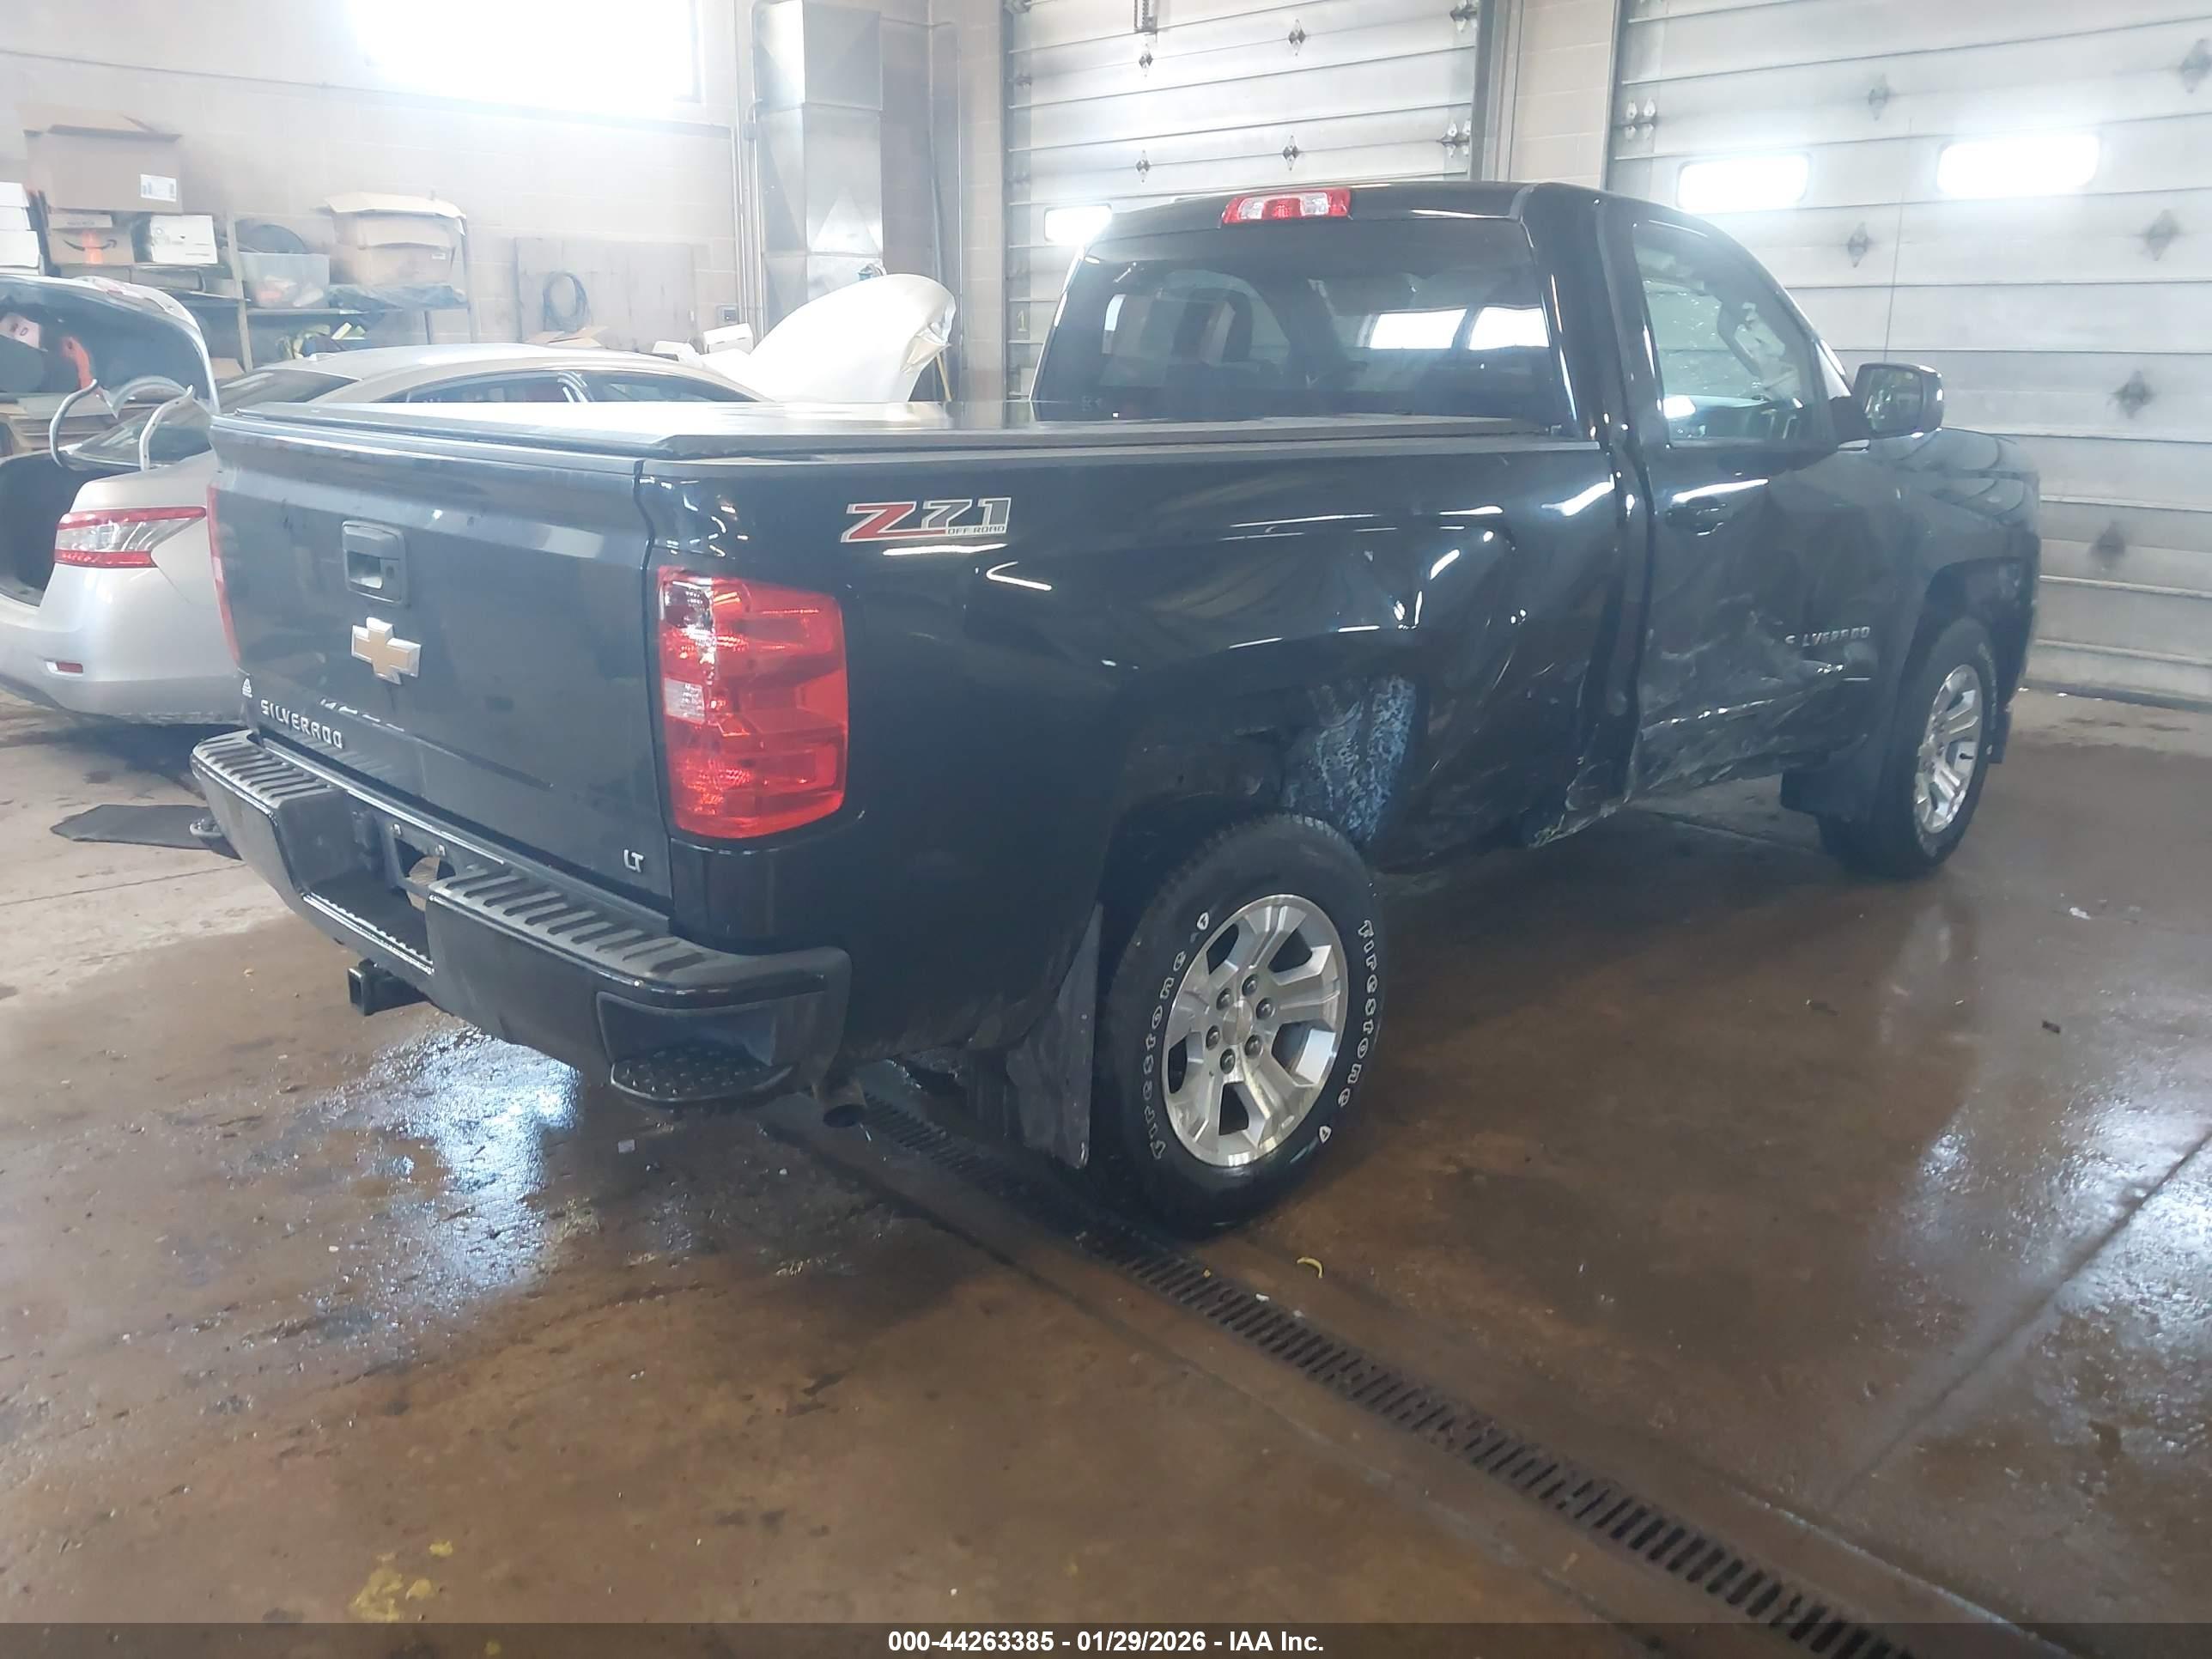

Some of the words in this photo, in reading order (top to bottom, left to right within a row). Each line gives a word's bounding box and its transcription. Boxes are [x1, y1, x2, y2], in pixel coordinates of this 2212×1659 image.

[841, 496, 1012, 543] Z71
[260, 699, 343, 749] SILVERADO
[623, 848, 644, 873] LT
